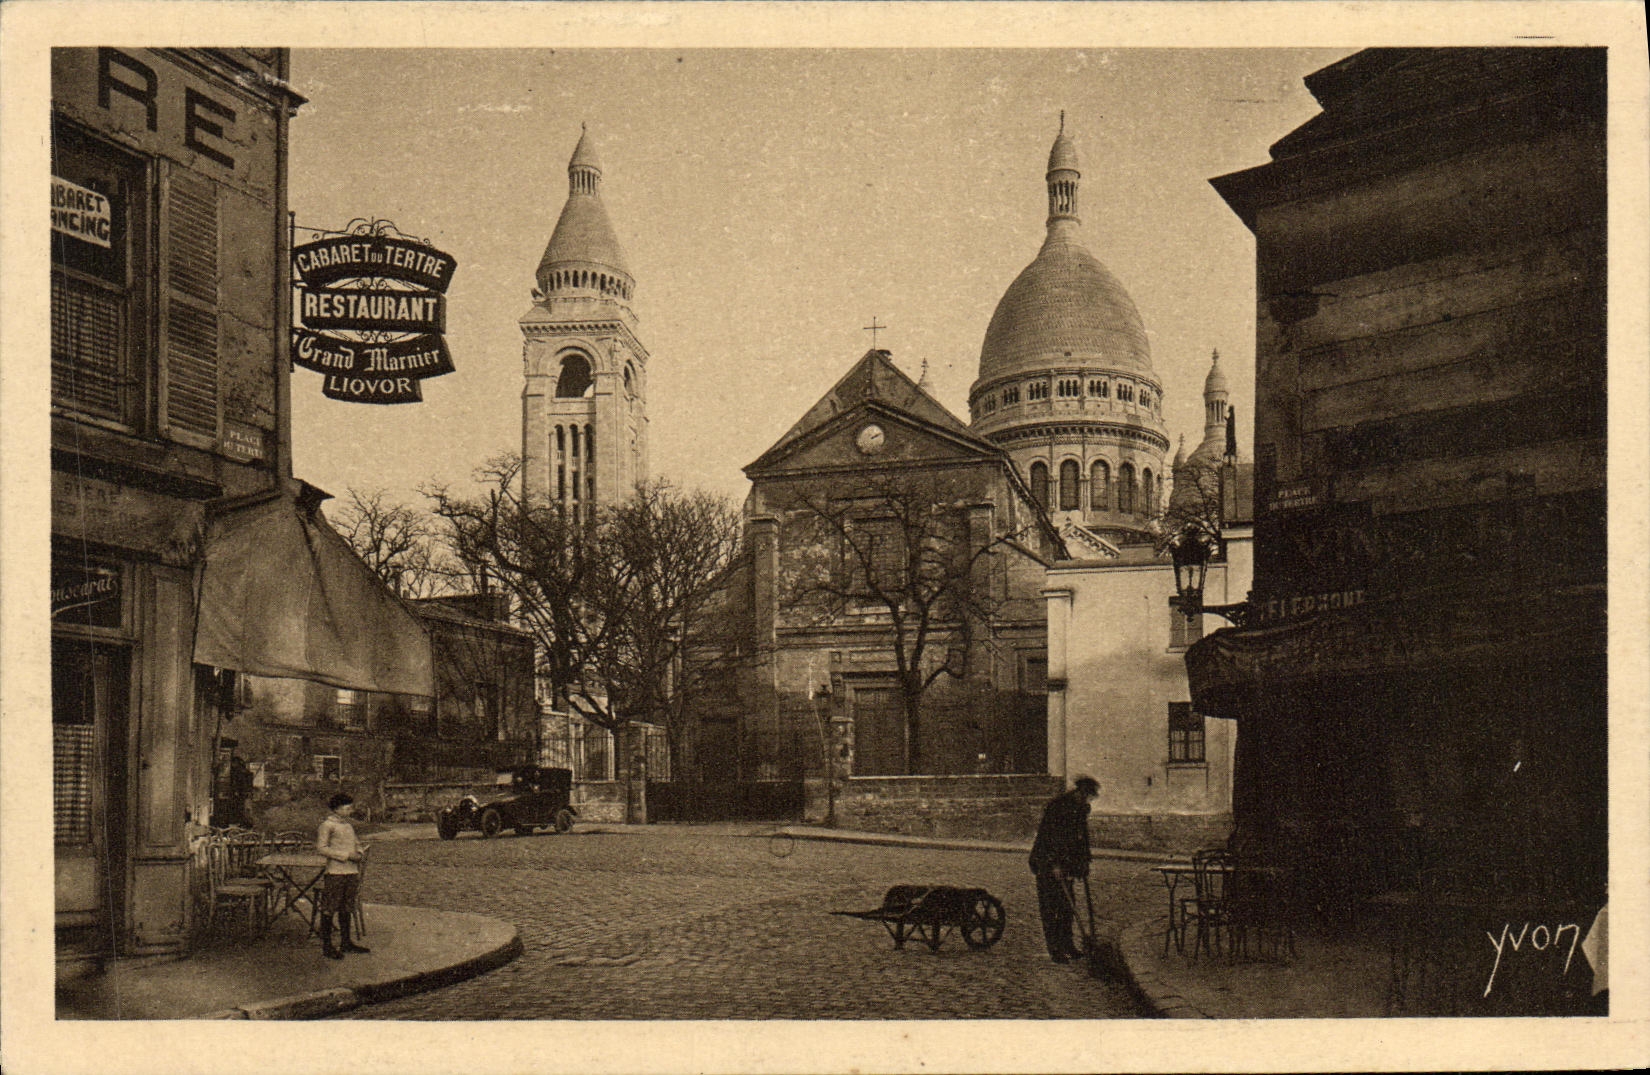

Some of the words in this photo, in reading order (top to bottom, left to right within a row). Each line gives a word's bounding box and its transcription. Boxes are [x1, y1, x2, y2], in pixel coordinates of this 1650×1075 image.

[298, 244, 371, 272] CABARET
[385, 245, 446, 278] TERTRE
[305, 293, 437, 322] RESTAURANT
[298, 336, 355, 369] Grand
[363, 347, 440, 372] Marnier
